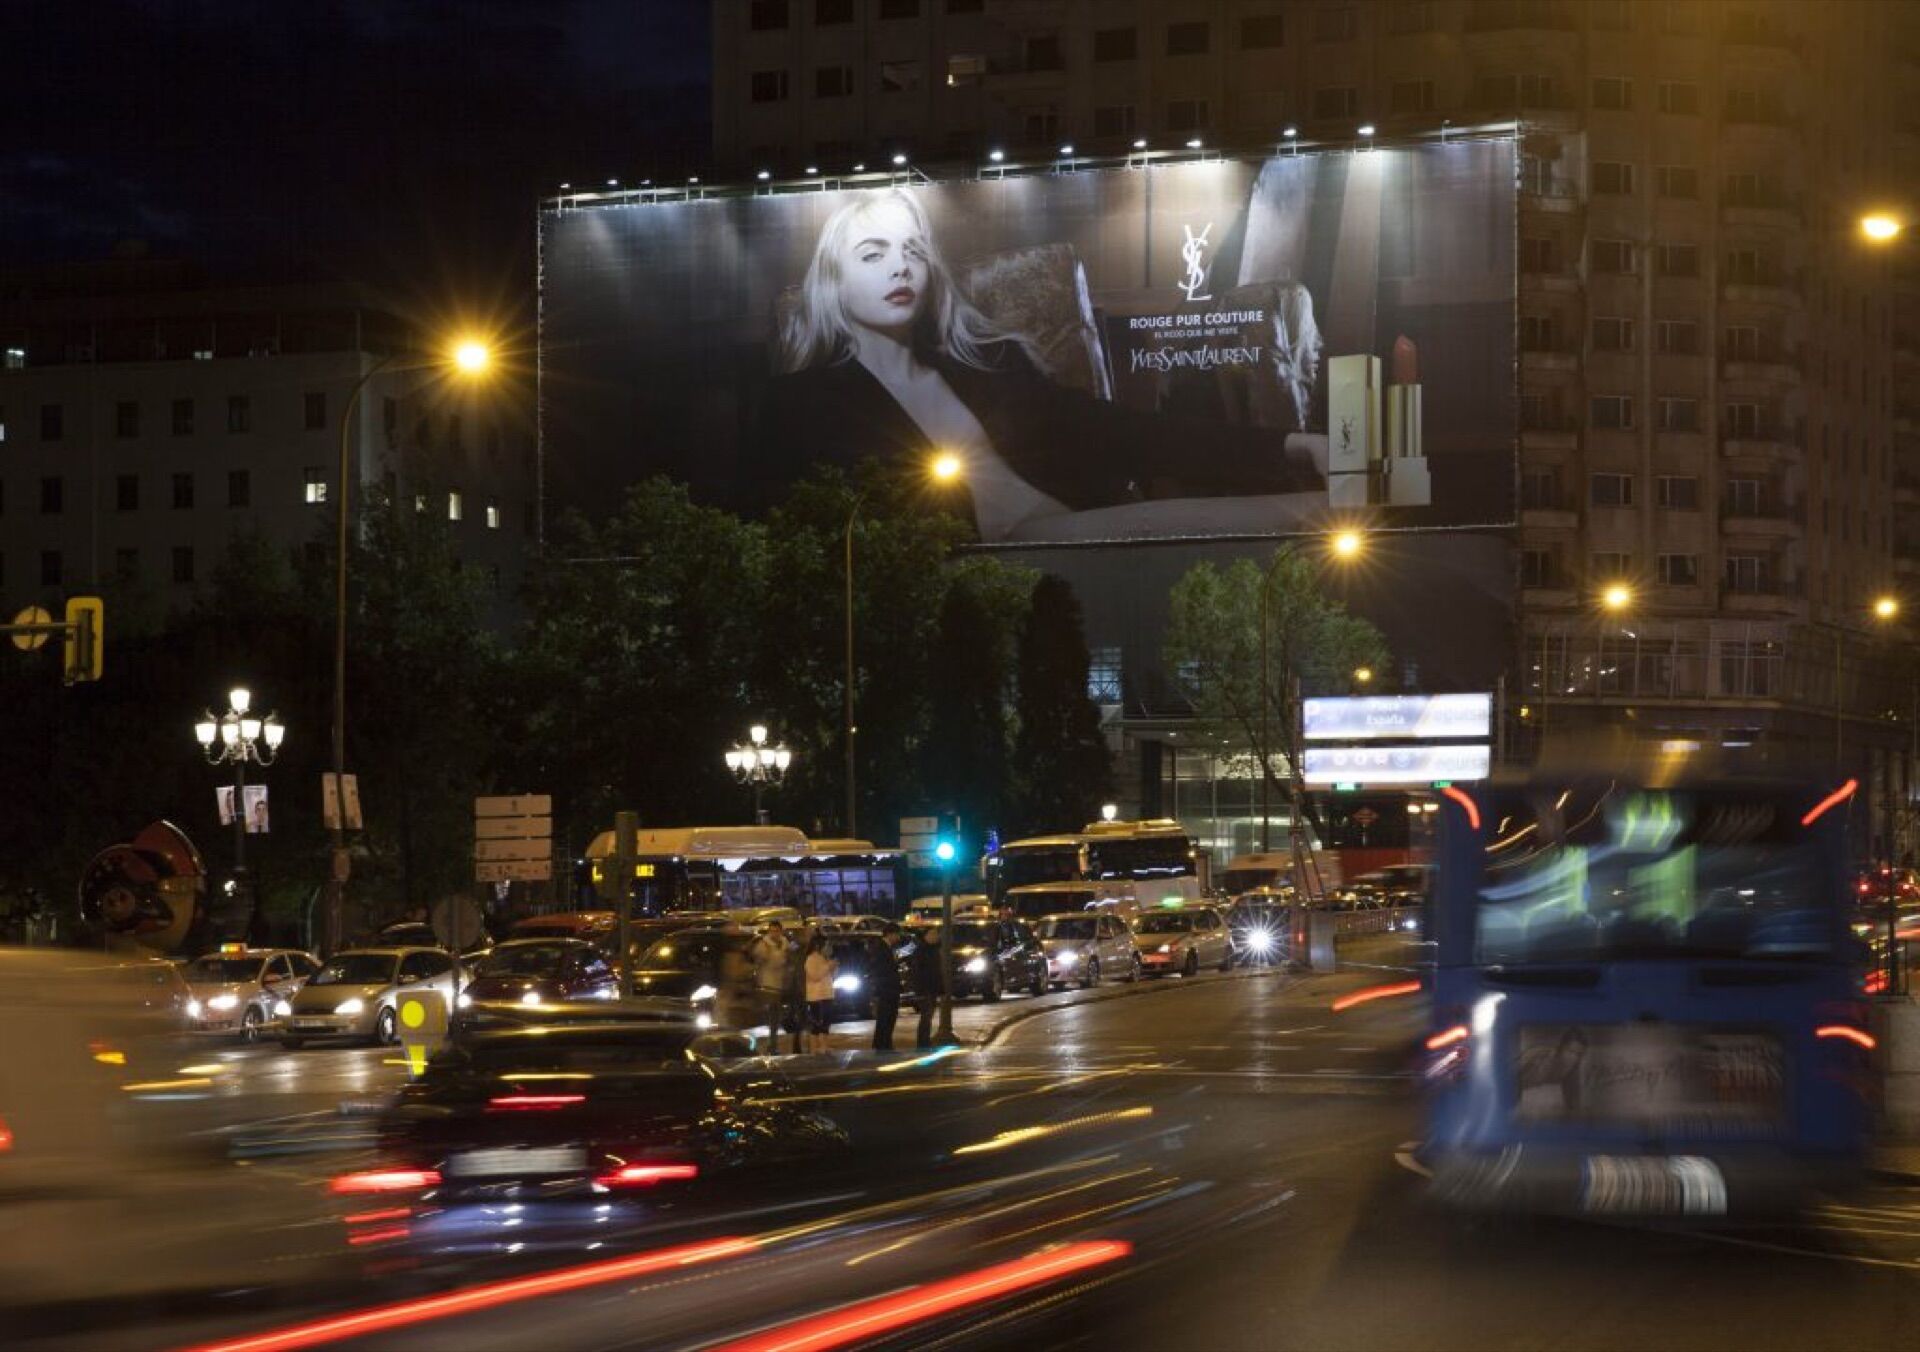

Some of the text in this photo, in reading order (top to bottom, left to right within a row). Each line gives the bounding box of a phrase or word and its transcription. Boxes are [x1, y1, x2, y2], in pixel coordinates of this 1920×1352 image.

[1130, 311, 1263, 329] ROUGE PUR COUTURE
